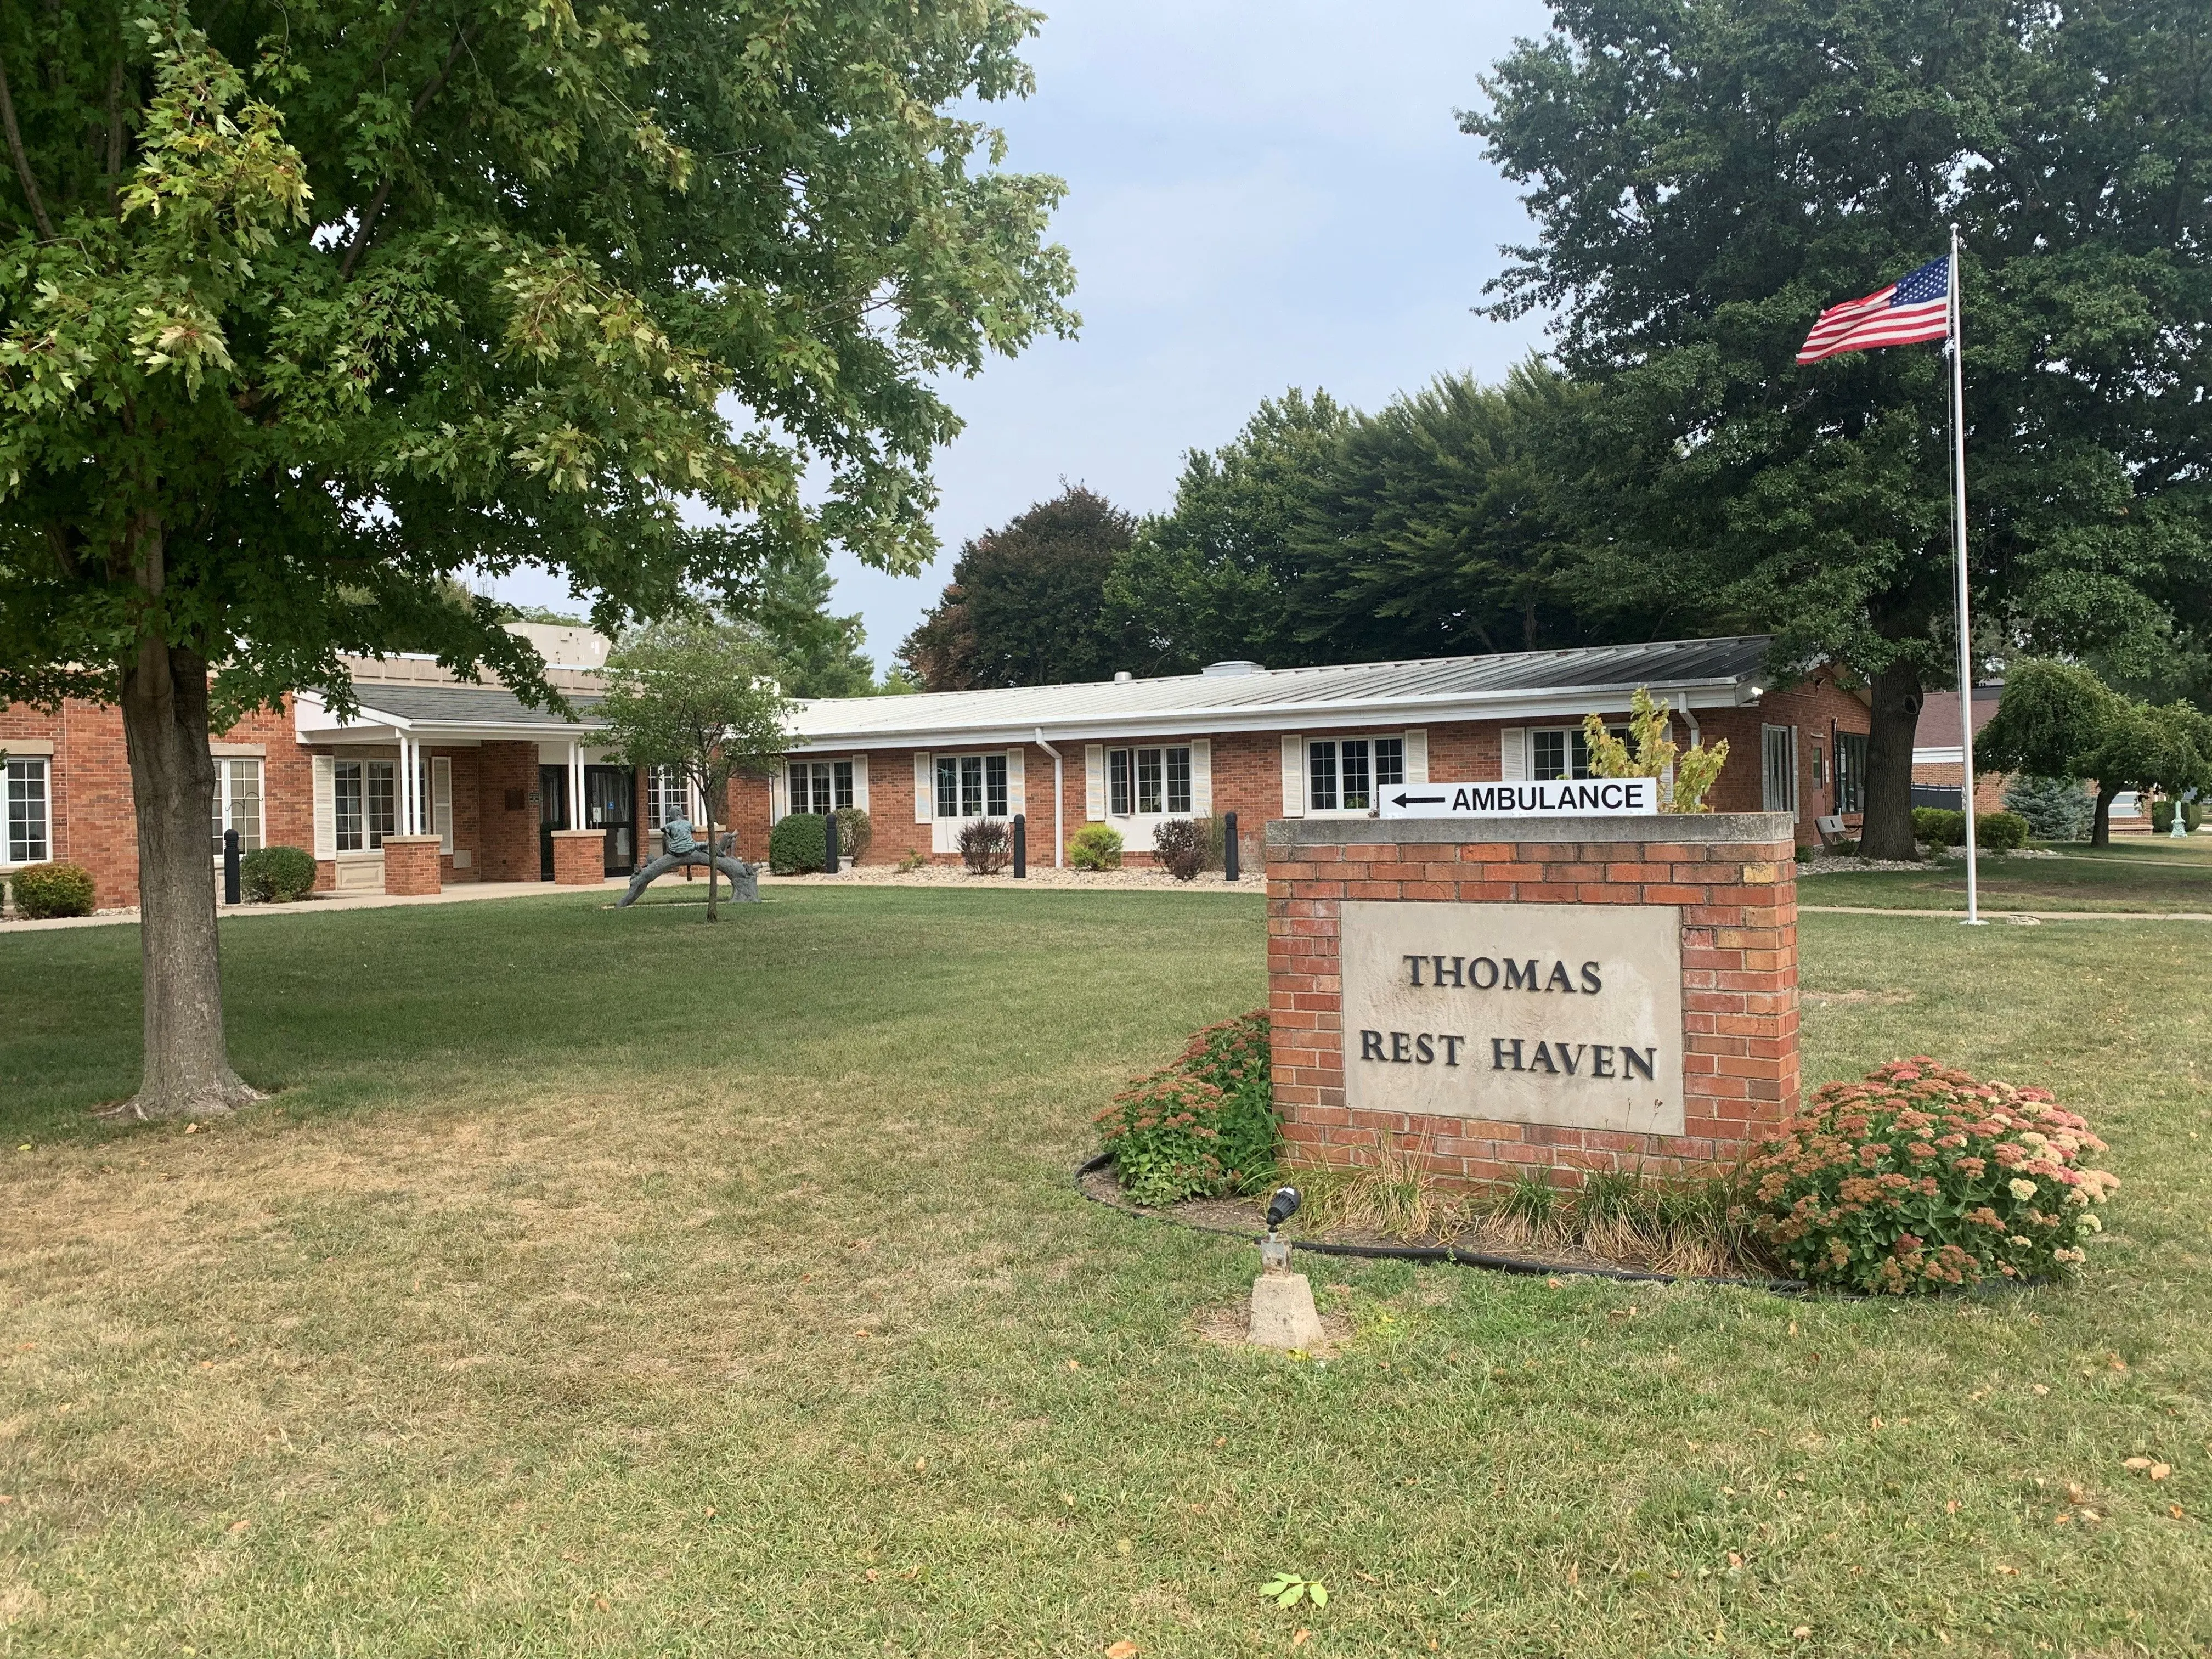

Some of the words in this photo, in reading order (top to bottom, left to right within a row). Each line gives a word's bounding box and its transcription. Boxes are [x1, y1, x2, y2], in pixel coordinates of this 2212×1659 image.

[1451, 783, 1644, 811] AMBULANCE
[1403, 955, 1602, 995] THOMAS
[1360, 1029, 1465, 1066] REST
[1491, 1037, 1658, 1081] HAVEN
